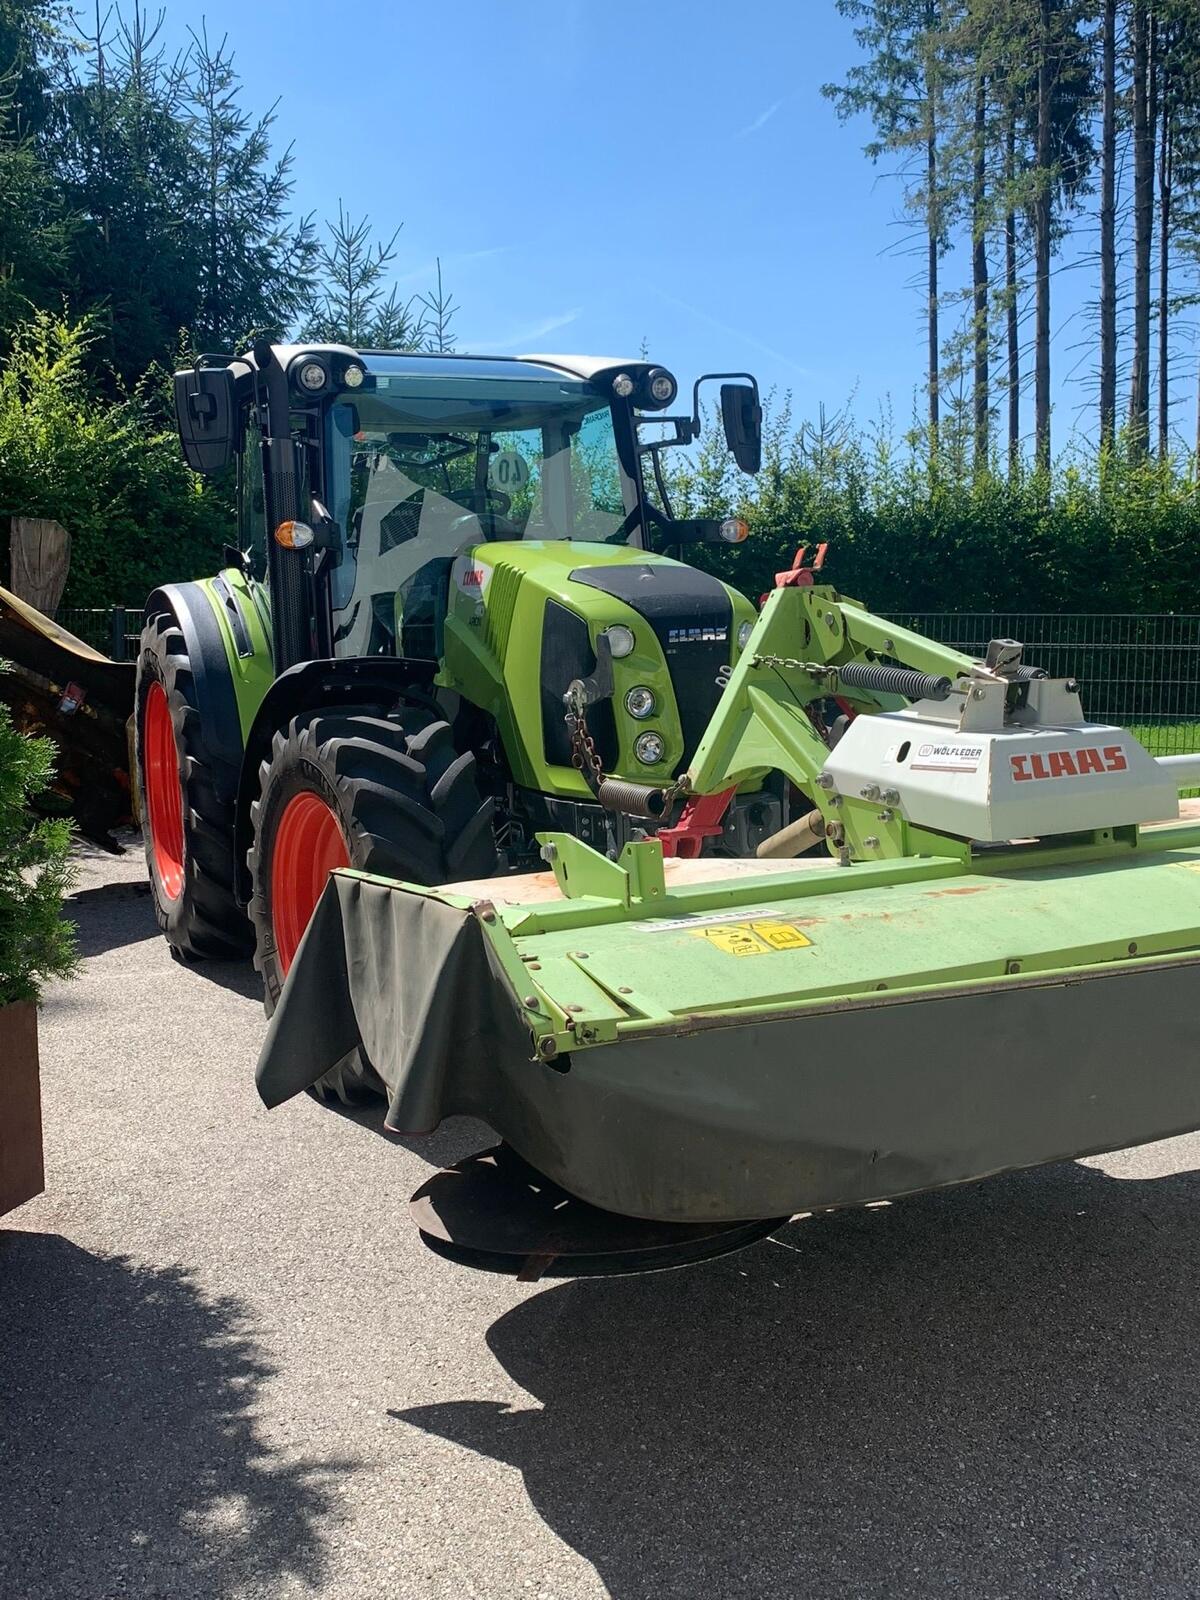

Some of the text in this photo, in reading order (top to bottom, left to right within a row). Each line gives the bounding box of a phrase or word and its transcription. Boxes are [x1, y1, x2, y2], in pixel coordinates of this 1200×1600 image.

[668, 627, 726, 643] CLAAS
[933, 744, 983, 757] WÖLFLEDER
[1010, 746, 1128, 782] CLAAS
